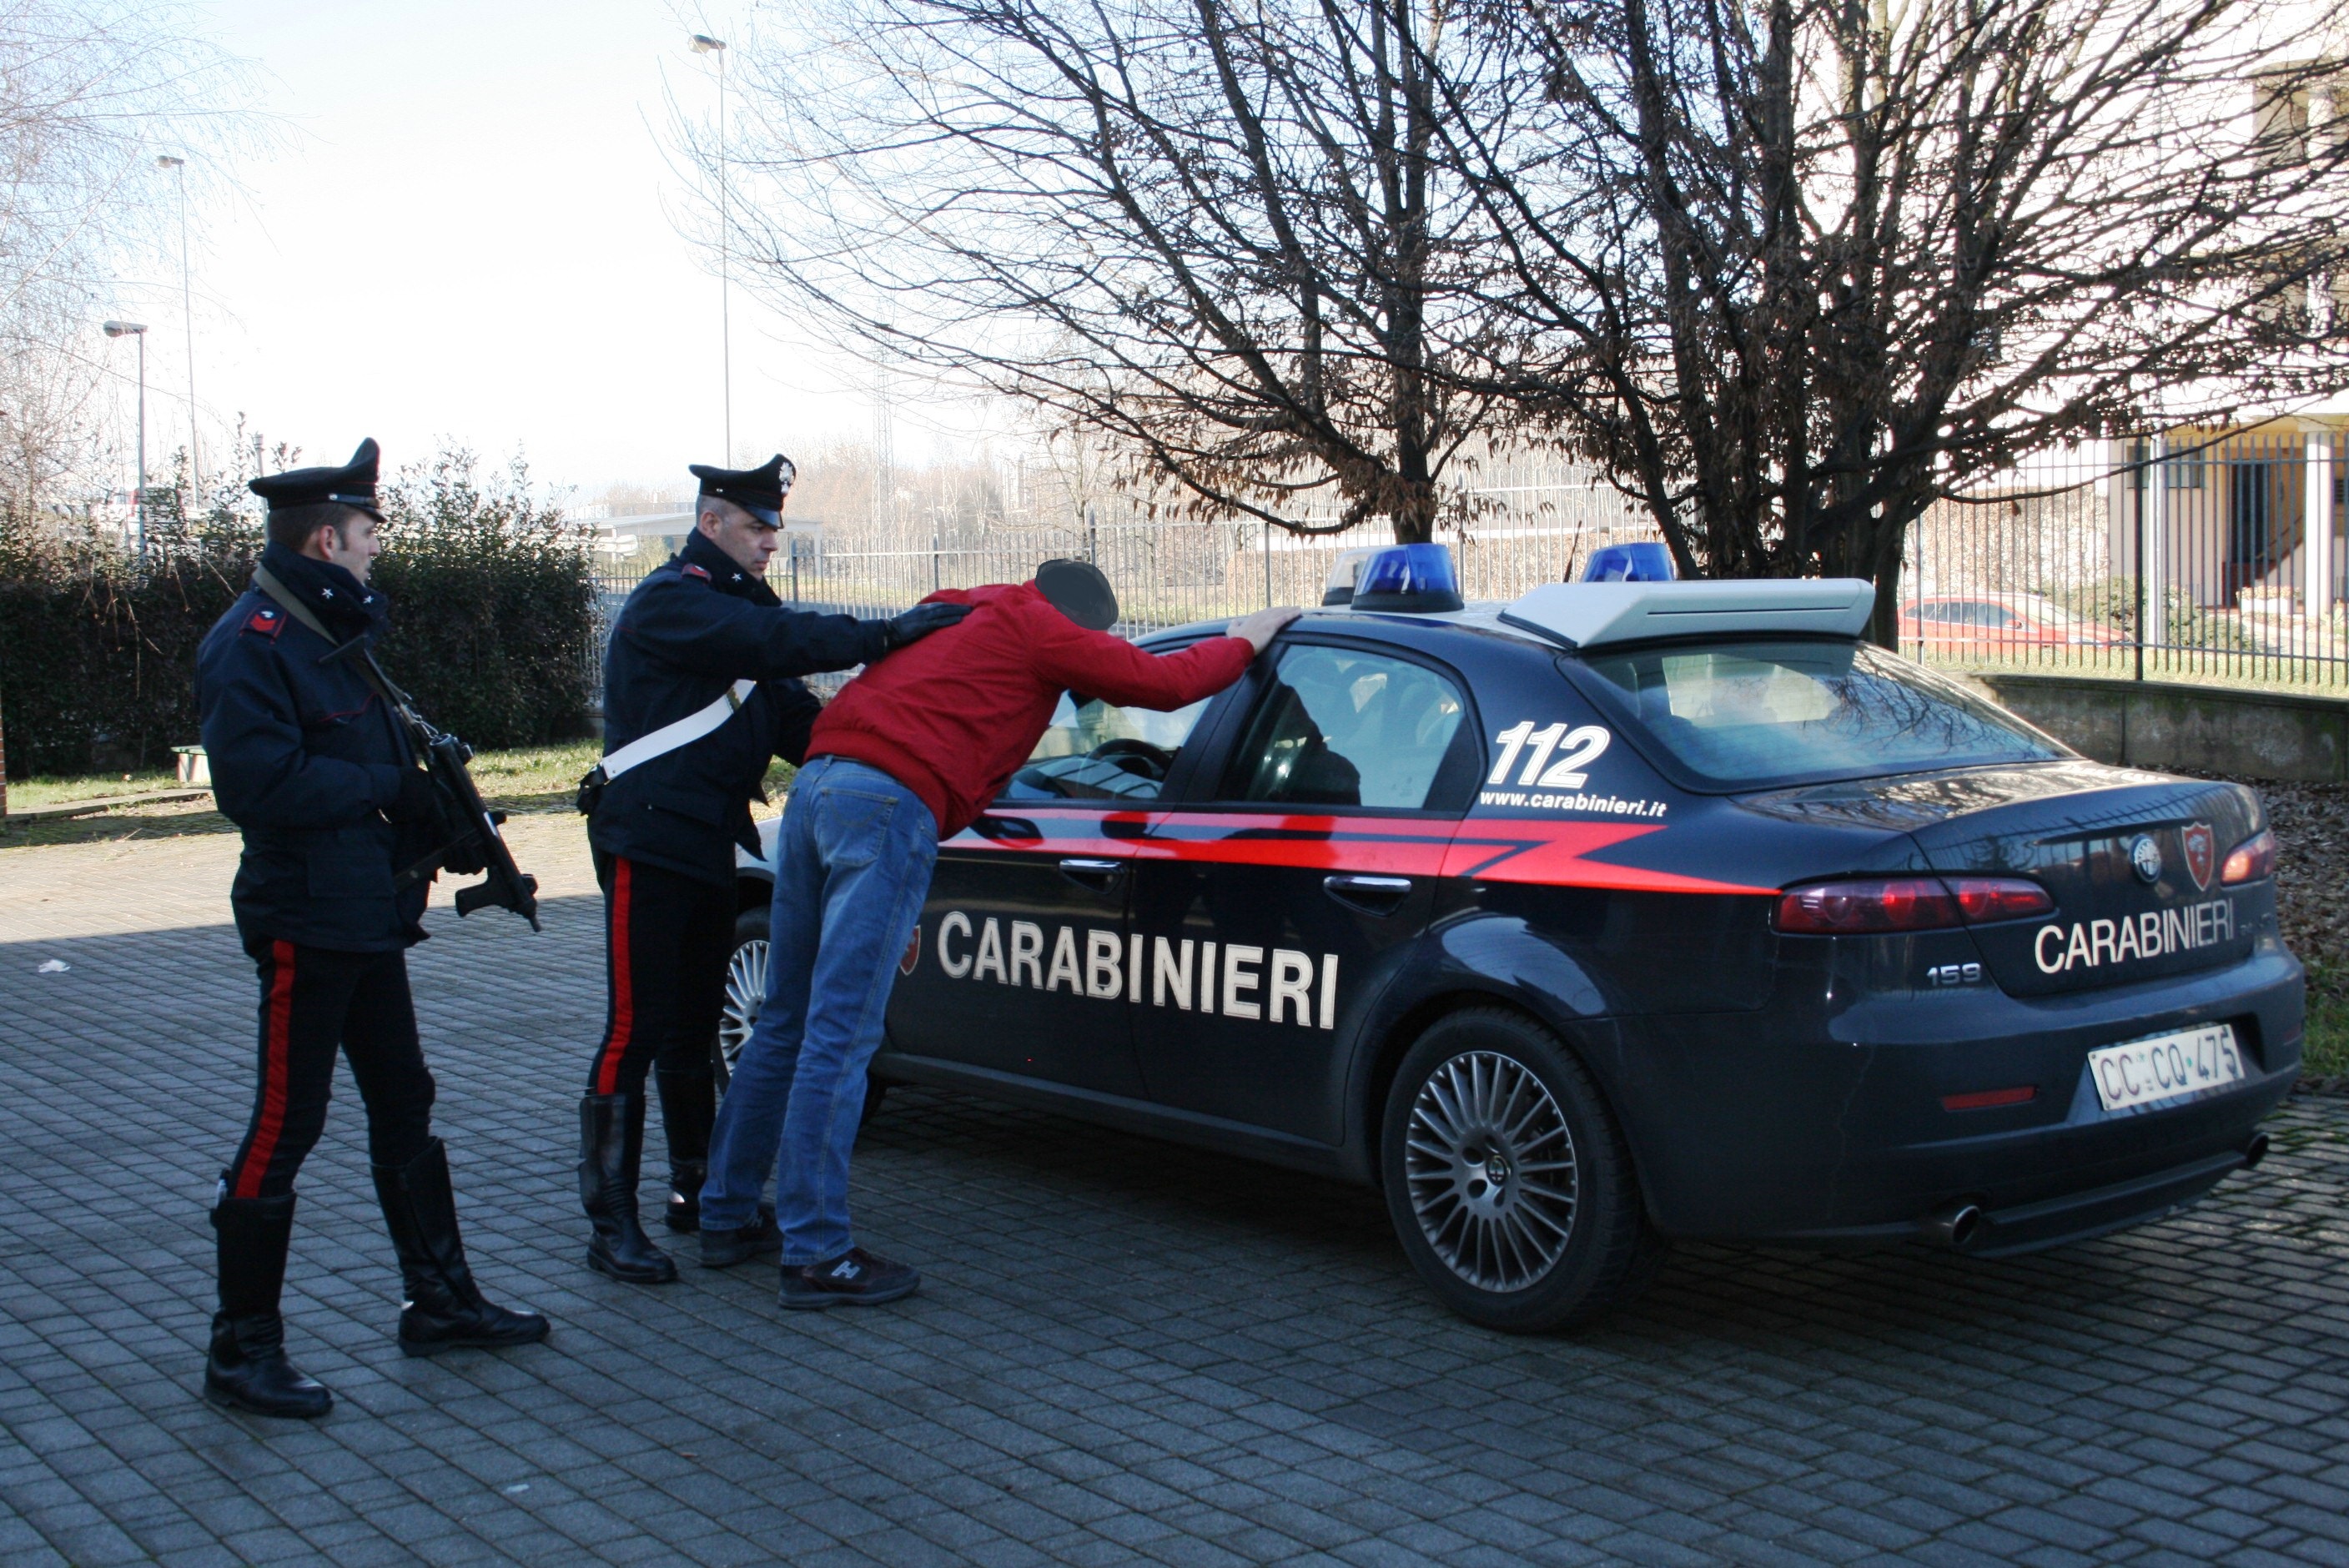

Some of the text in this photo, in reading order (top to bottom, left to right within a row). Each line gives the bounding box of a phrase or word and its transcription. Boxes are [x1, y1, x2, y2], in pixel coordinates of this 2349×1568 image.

[1488, 721, 1611, 789] 112
[1480, 792, 1667, 817] www.carabinieri.it
[2035, 897, 2235, 974] CARABINIERI
[938, 911, 1339, 1030] CARABINIERI
[1927, 962, 1981, 986] 159
